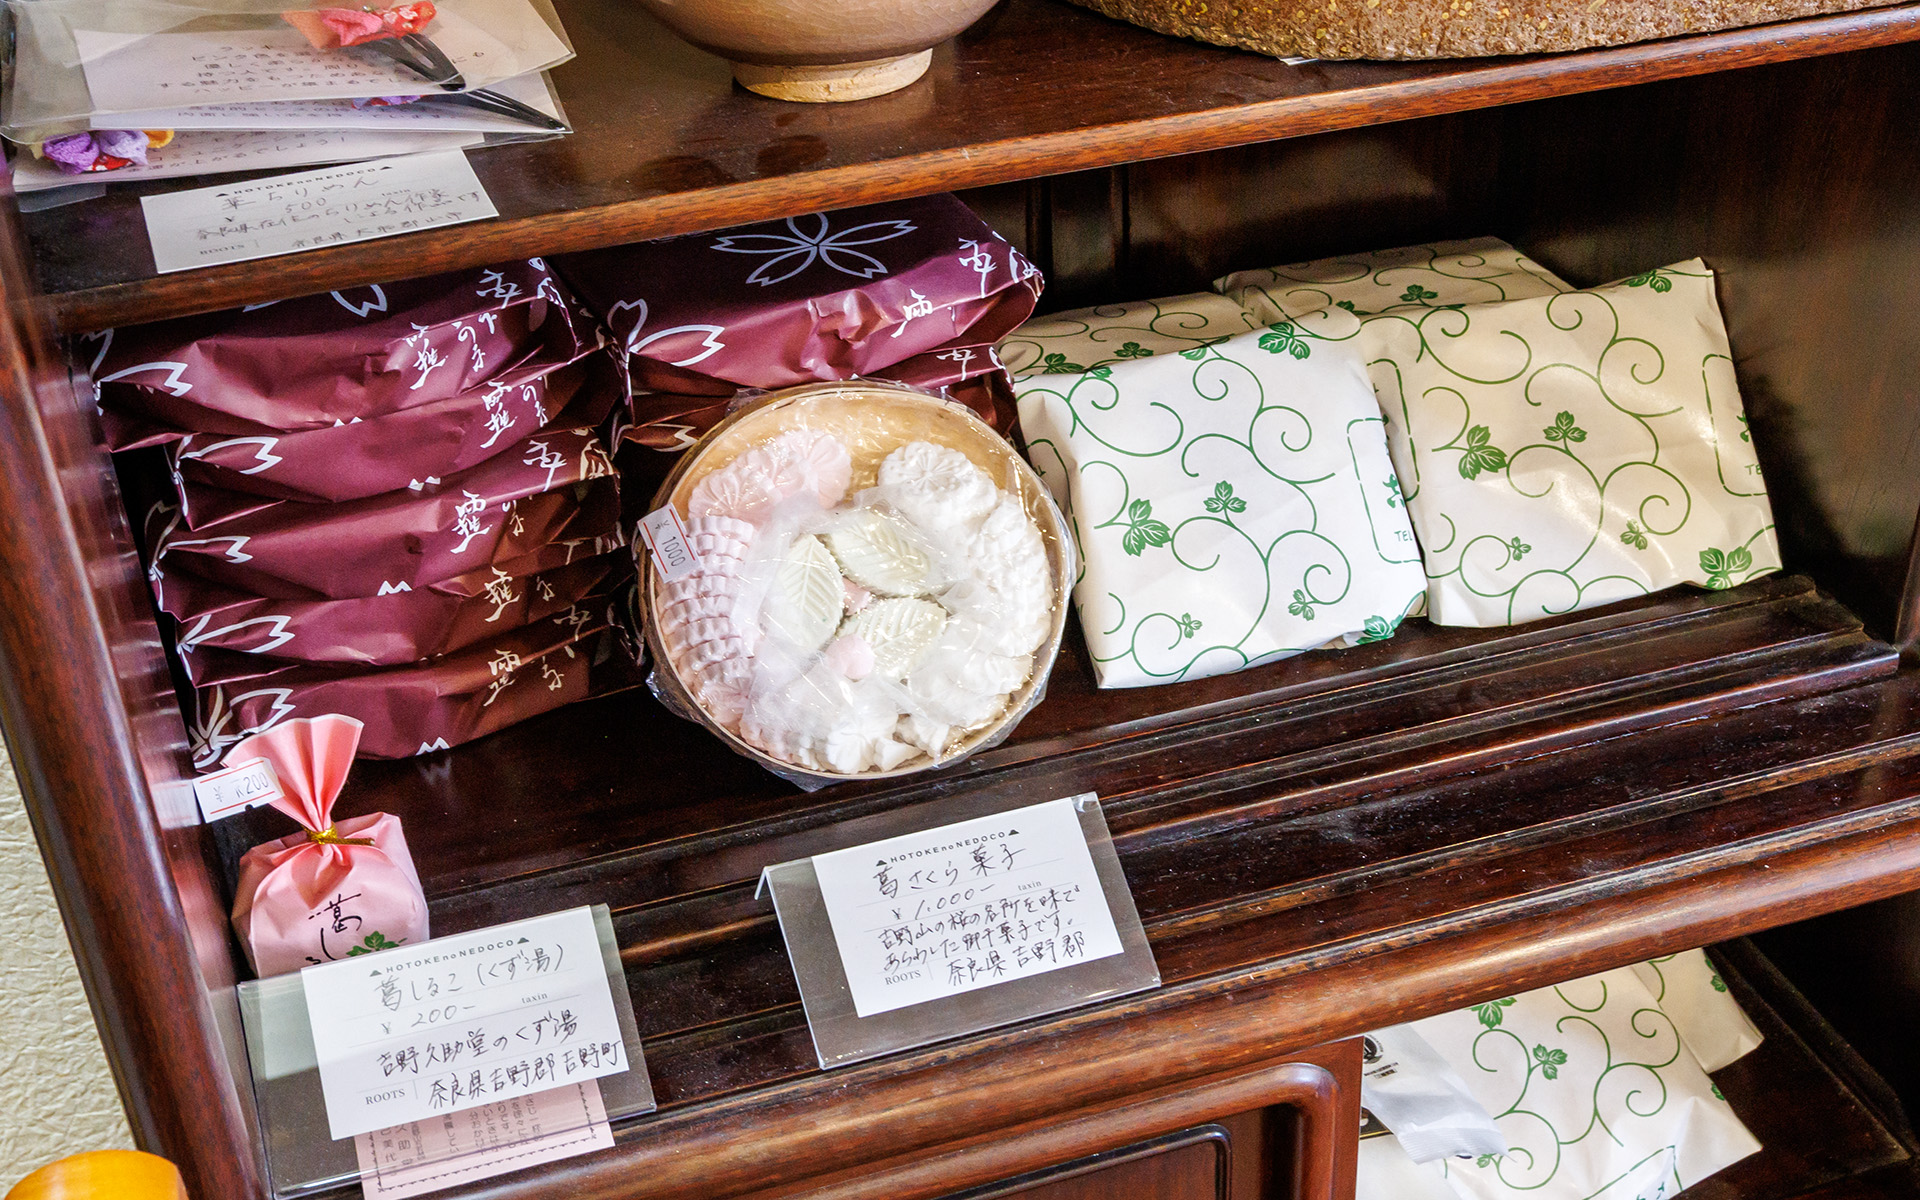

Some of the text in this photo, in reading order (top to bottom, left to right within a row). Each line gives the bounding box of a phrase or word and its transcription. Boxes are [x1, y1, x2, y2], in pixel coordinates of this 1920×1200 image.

[284, 196, 329, 214] 500
[661, 535, 687, 567] 1000
[889, 829, 1007, 864] HOTOKEnoNEDOCO
[892, 908, 902, 920] ¥
[1017, 879, 1043, 892] taxin
[385, 937, 515, 974] HOTOKEnoNEDOCO
[884, 969, 922, 986] ROOTS
[380, 1021, 393, 1035] ¥
[521, 991, 549, 1005] taxin
[364, 1087, 407, 1106] ROOTS
